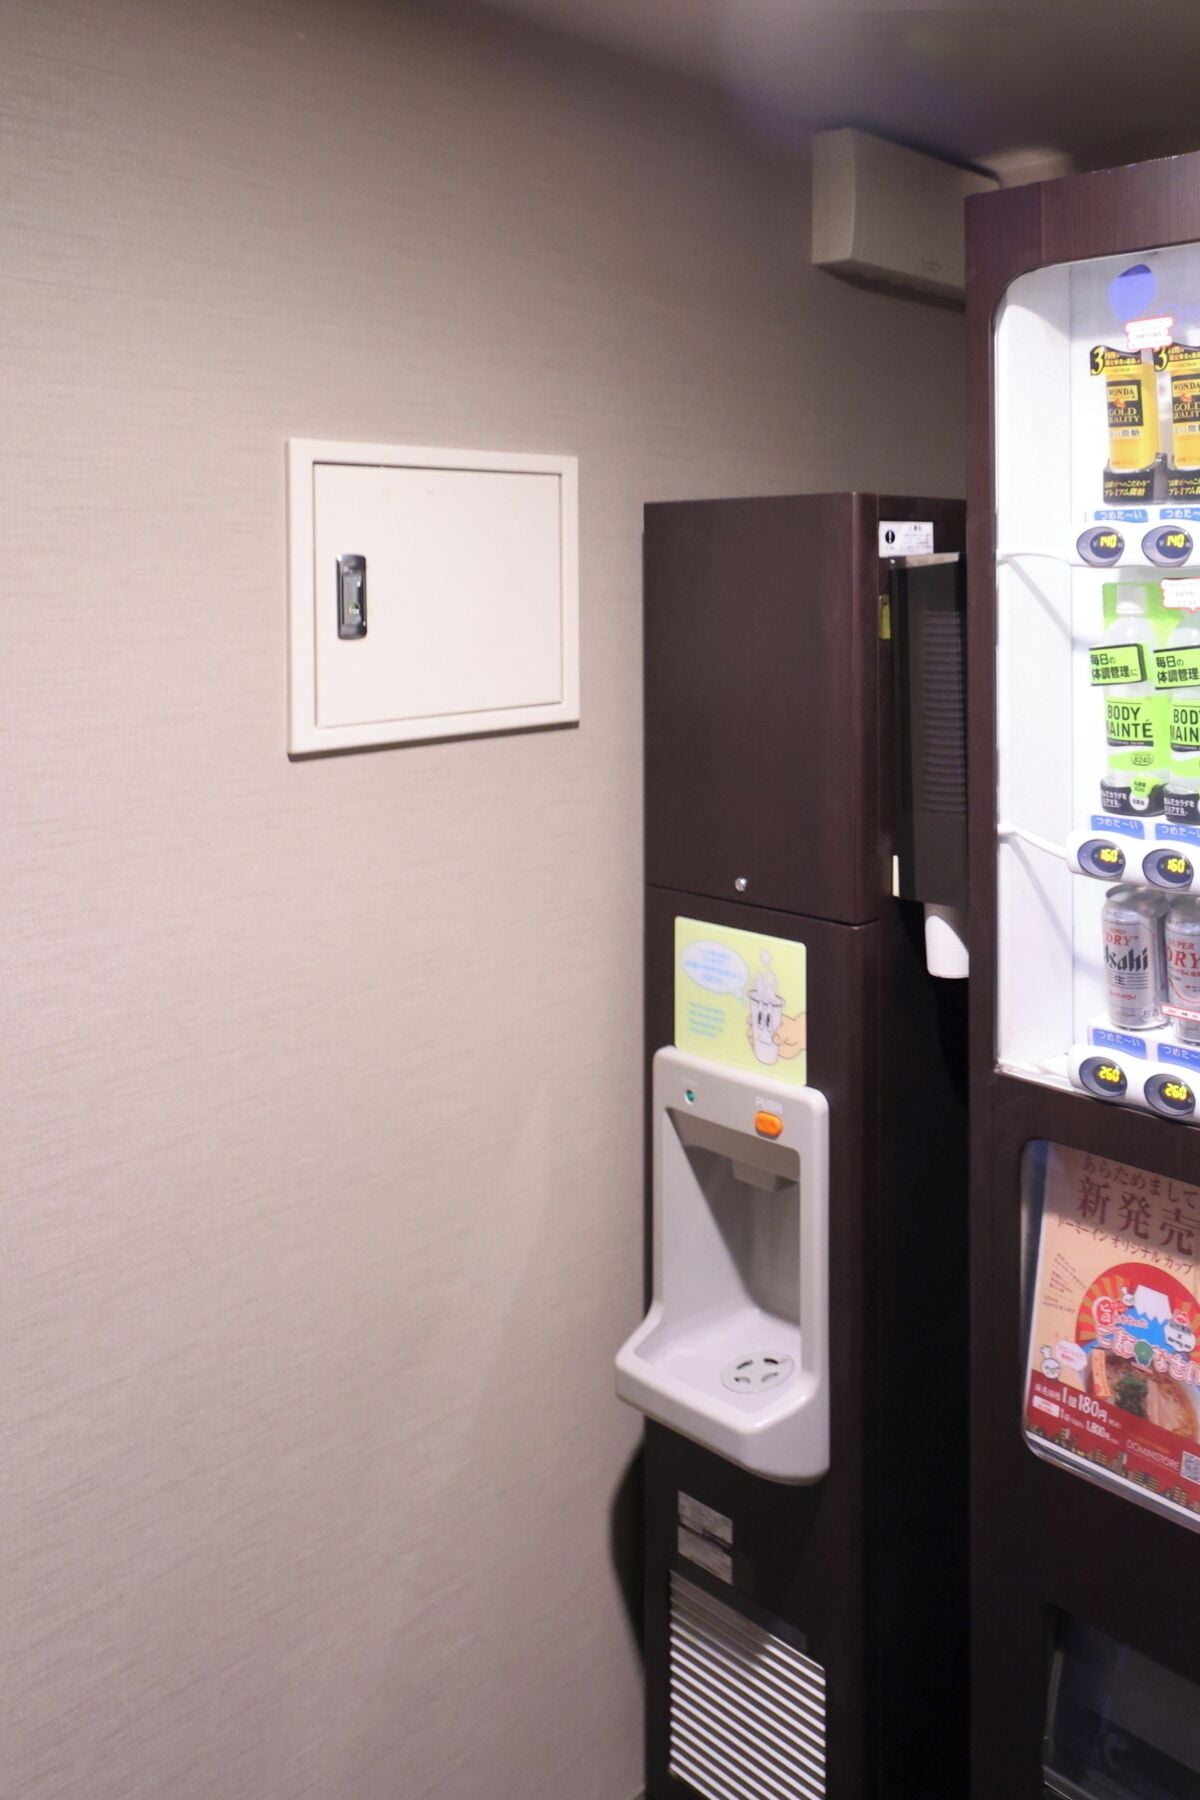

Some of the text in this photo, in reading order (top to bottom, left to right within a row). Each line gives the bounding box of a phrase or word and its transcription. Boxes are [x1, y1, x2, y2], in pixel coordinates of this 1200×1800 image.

[1091, 654, 1116, 665] 毎日の
[1156, 656, 1184, 669] 毎日の
[1091, 666, 1138, 680] 体調管理に
[1107, 704, 1141, 721] BODY
[1100, 849, 1118, 863] 160
[1081, 1153, 1200, 1209] あらためまして
[1076, 1175, 1195, 1257] 新発売
[1111, 1232, 1161, 1264] オリジナル
